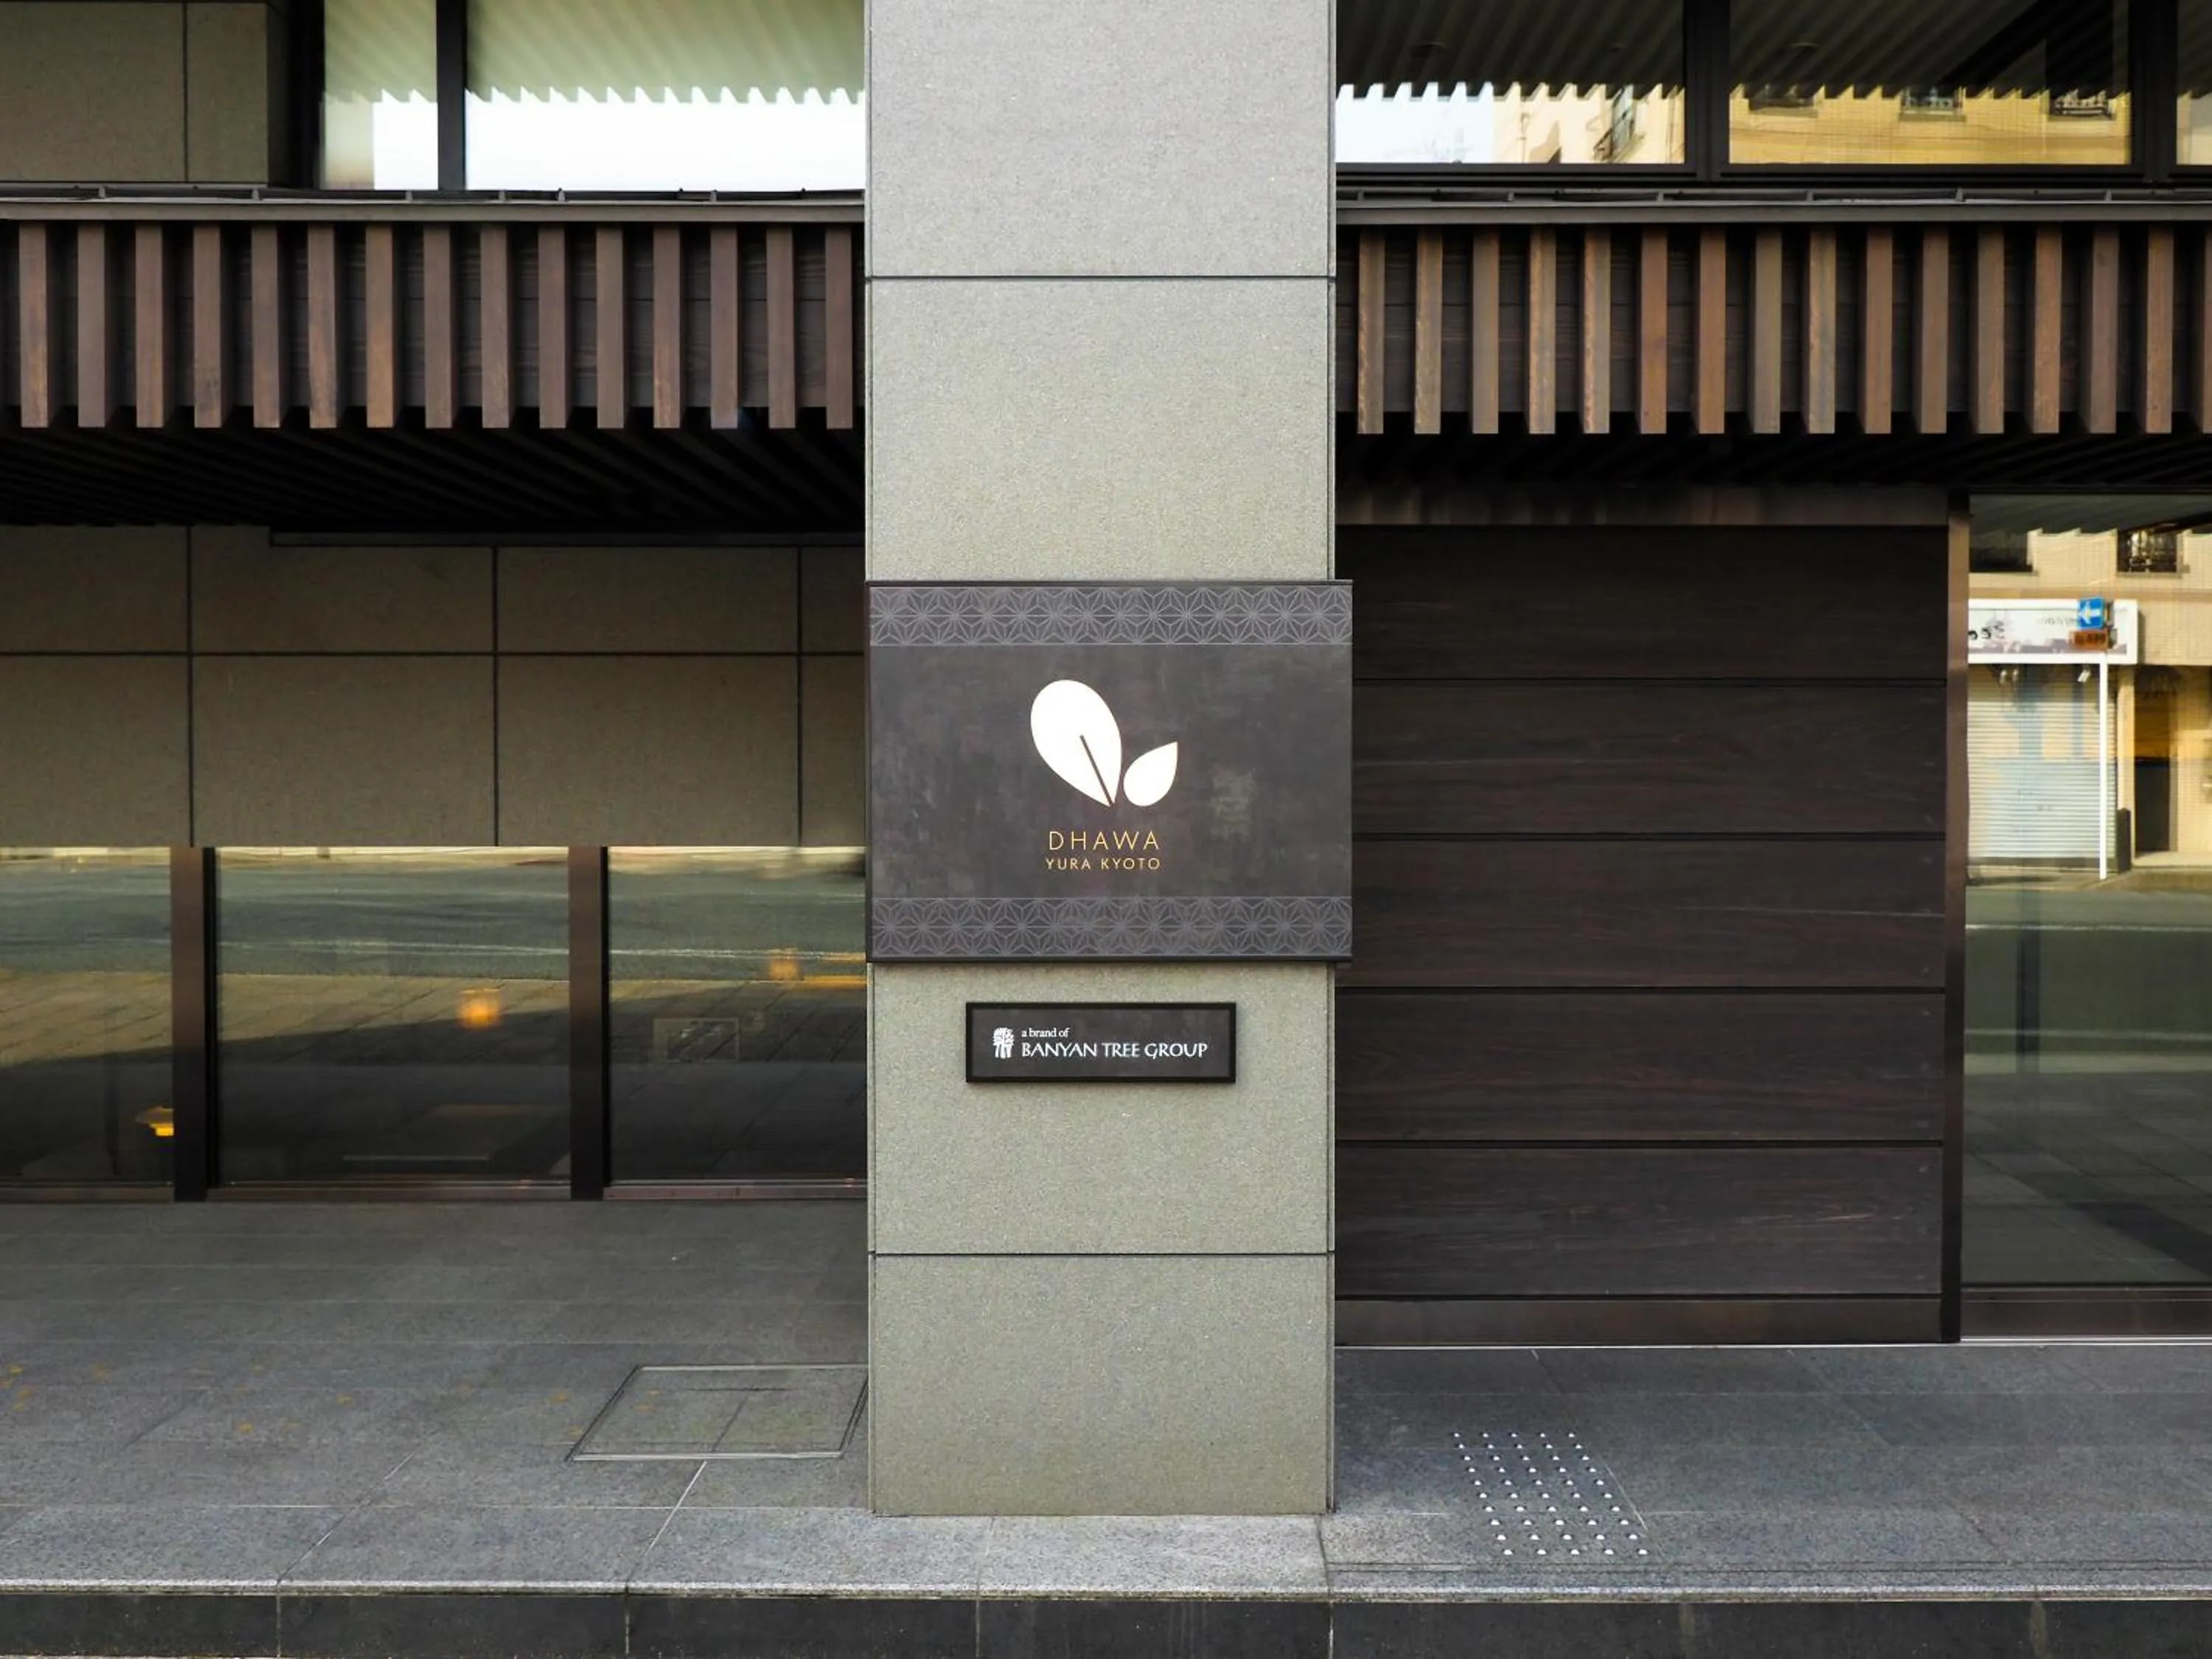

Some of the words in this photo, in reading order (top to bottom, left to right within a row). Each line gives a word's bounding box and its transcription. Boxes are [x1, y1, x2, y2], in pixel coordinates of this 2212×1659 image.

[1048, 830, 1161, 850] DHAWA
[1046, 858, 1091, 870] YURA
[1101, 858, 1161, 870] KYOTO
[1029, 1028, 1057, 1037] brand
[1058, 1028, 1070, 1037] of
[1021, 1043, 1097, 1057] BANYAN
[1101, 1042, 1140, 1057] TREE
[1144, 1043, 1208, 1060] GROUP
